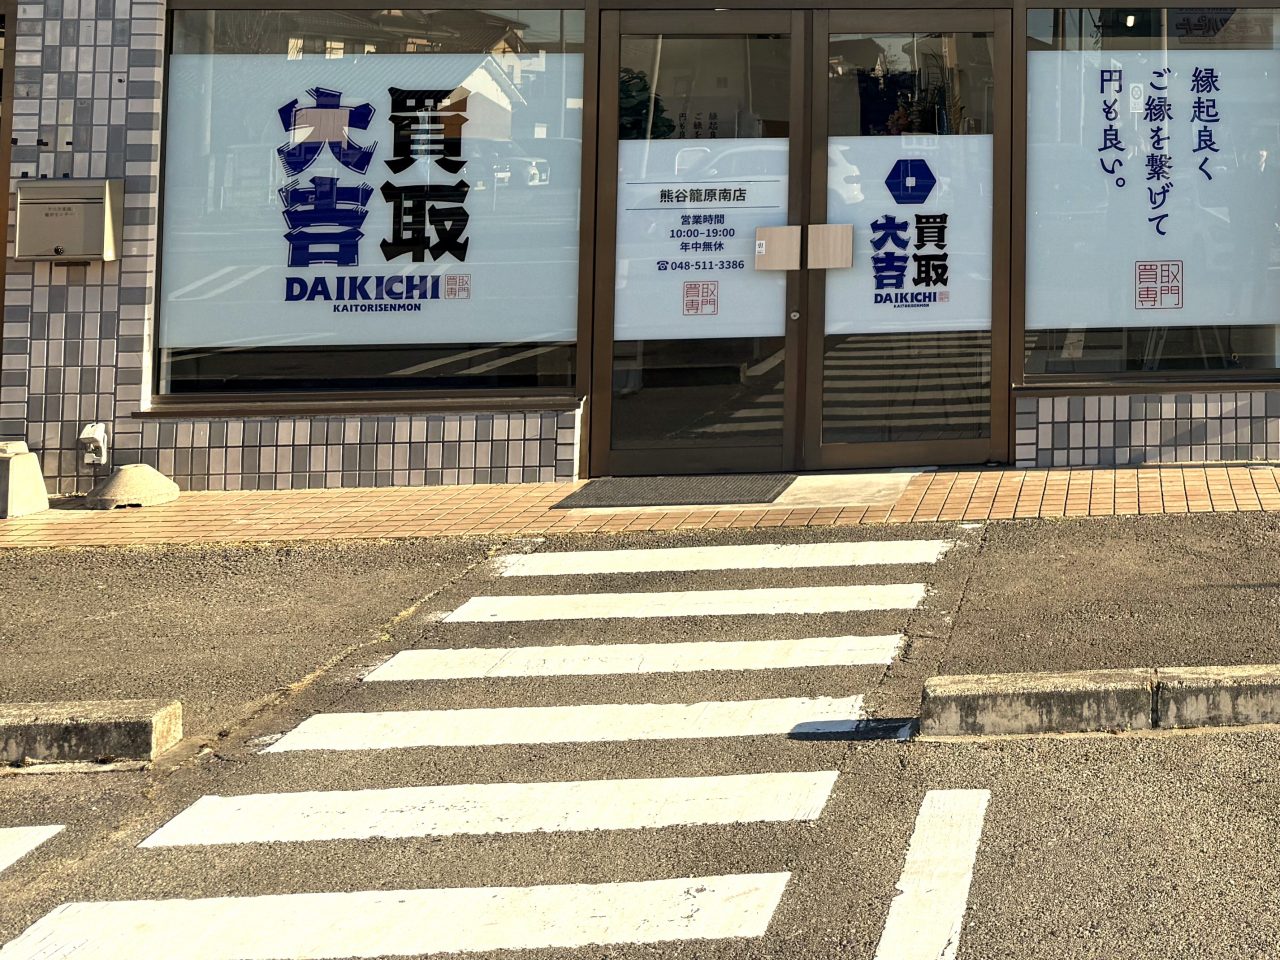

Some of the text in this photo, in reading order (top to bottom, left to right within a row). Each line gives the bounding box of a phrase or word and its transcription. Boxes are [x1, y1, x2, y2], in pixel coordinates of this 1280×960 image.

[1098, 69, 1126, 187] 円も良い。
[1190, 67, 1220, 181] 縁起良く
[277, 86, 378, 267] 大吉
[380, 86, 471, 262] 買取
[1143, 67, 1174, 236] ご縁を繋げて
[660, 188, 747, 202] 熊谷籠原南店
[681, 214, 725, 225] 営業時間
[670, 260, 745, 270] 048-511-3386
[680, 241, 724, 252] 年中無休
[870, 214, 911, 289] 大吉
[912, 213, 949, 287] 買取
[285, 275, 442, 301] DAIKICHI
[333, 303, 421, 313] KAITORISENMON
[874, 292, 937, 304] DAIKICHI
